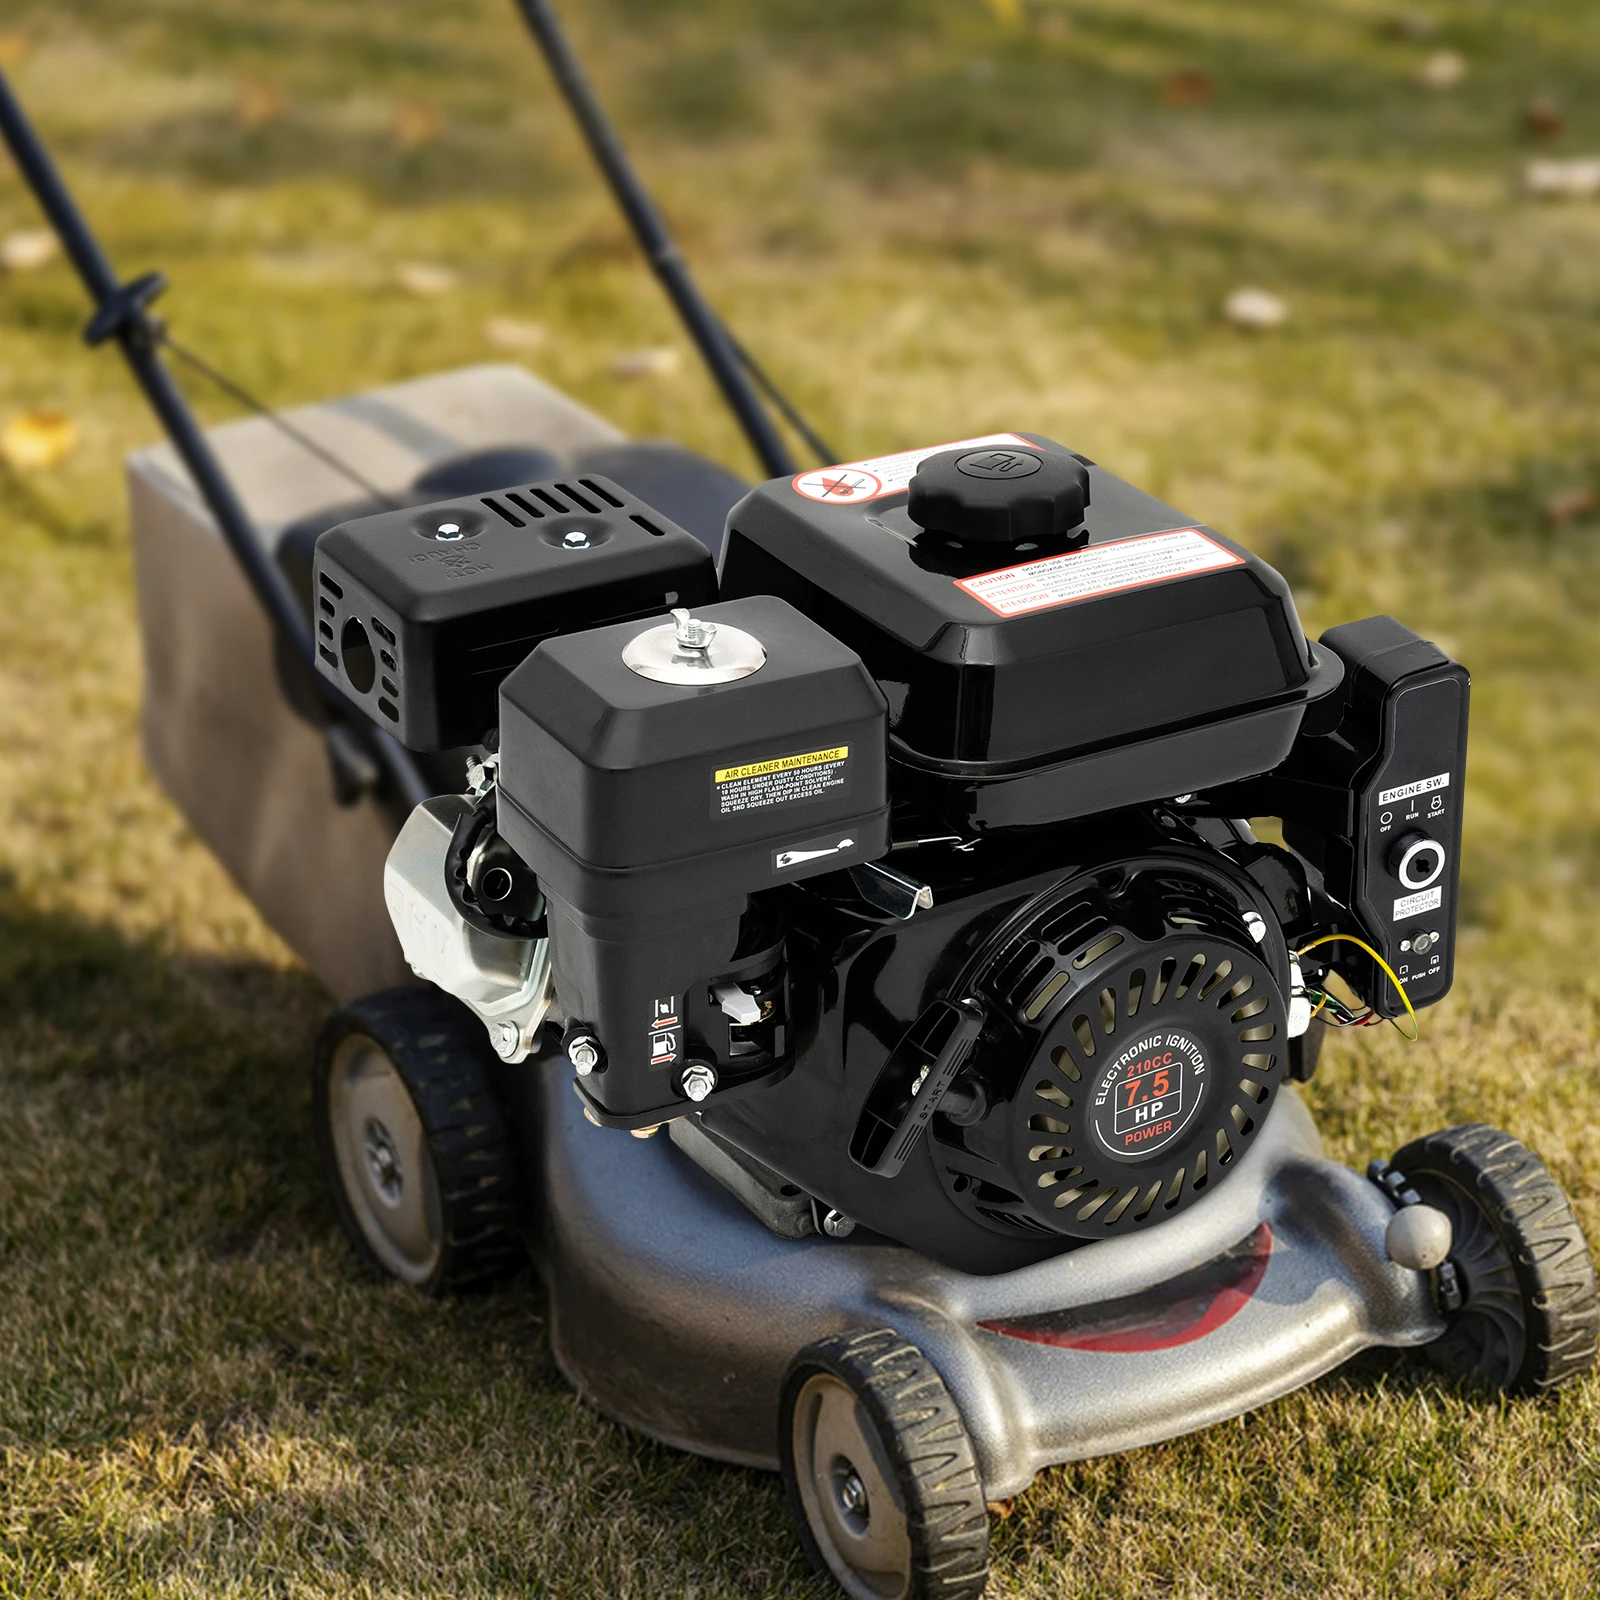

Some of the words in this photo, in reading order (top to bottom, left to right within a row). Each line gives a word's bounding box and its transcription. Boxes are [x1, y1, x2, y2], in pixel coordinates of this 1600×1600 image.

[971, 572, 1016, 588] CAUTION
[986, 583, 1036, 599] ATTENTION
[1000, 593, 1050, 609] ATENCION
[721, 781, 742, 790] CLEAN
[743, 775, 771, 786] ELEMENT
[772, 771, 792, 780] EVERY
[802, 765, 822, 774] HOURS
[823, 760, 845, 770] (EVERY
[724, 769, 738, 780] AIR
[741, 762, 780, 776] CLEANER
[782, 750, 840, 768] MAINTENANCE
[721, 793, 739, 802] WASH
[748, 788, 762, 796] HIGH
[764, 780, 803, 793] FLASH-POINT
[721, 797, 749, 808] SQUEEZE
[802, 783, 822, 791] CLEAN
[822, 778, 844, 788] ENGINE
[730, 785, 750, 794] HOURS
[752, 780, 773, 790] UNDER
[774, 776, 794, 785] DUSTY
[746, 798, 774, 808] SQUEEZE
[790, 790, 812, 800] EXCESS
[1406, 812, 1419, 820] RUN
[1427, 808, 1446, 818] START
[1395, 898, 1439, 917] PROTECTOR
[1400, 891, 1434, 908] CIRCUIT
[1412, 972, 1426, 980] PUSH
[1428, 966, 1440, 974] OFF
[1095, 1036, 1162, 1106] ELECTRONIC
[1166, 1034, 1205, 1076] IGNITION
[1127, 1052, 1172, 1078] 210CC
[1125, 1070, 1170, 1107] 7.5
[919, 1080, 946, 1120] START
[1135, 1102, 1164, 1124] HP
[1125, 1120, 1172, 1146] POWER
